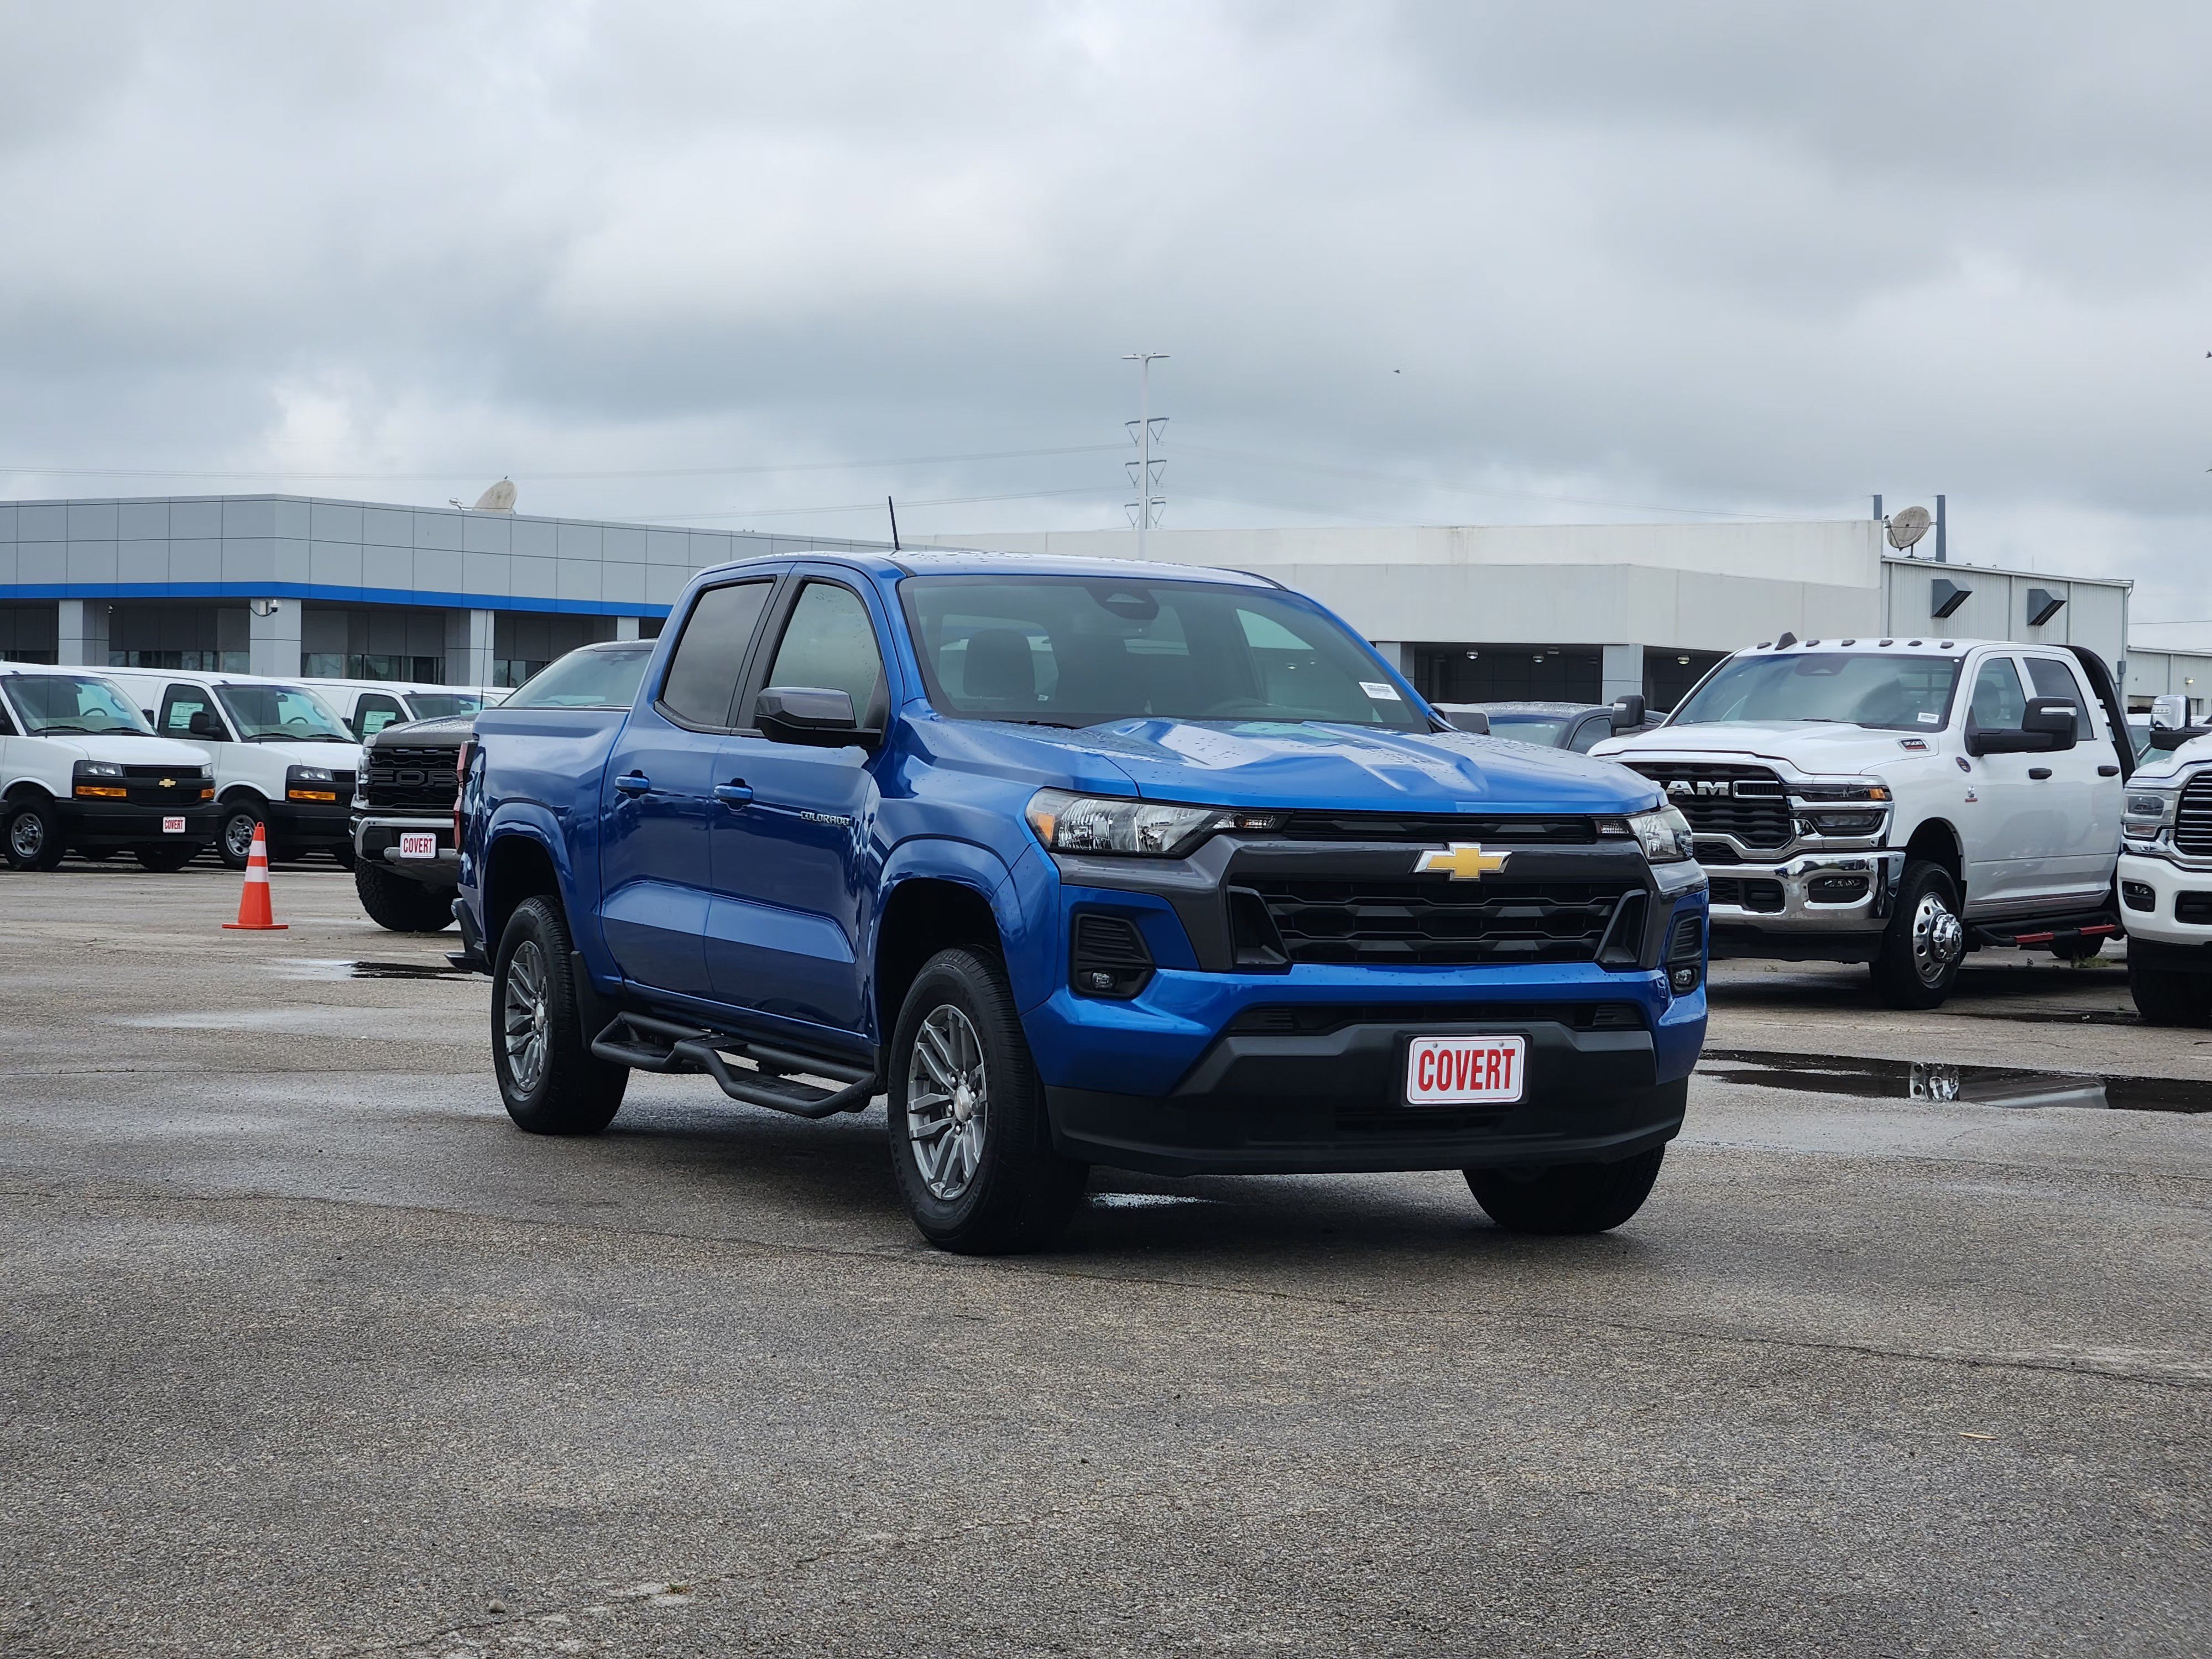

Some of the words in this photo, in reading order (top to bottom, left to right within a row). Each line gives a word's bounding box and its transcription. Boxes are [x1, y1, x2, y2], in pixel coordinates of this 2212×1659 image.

[368, 770, 458, 785] FOR
[165, 820, 183, 830] COVERT
[800, 811, 849, 825] COLORADO
[403, 838, 432, 853] COVERT
[1418, 1048, 1515, 1092] COVERT
